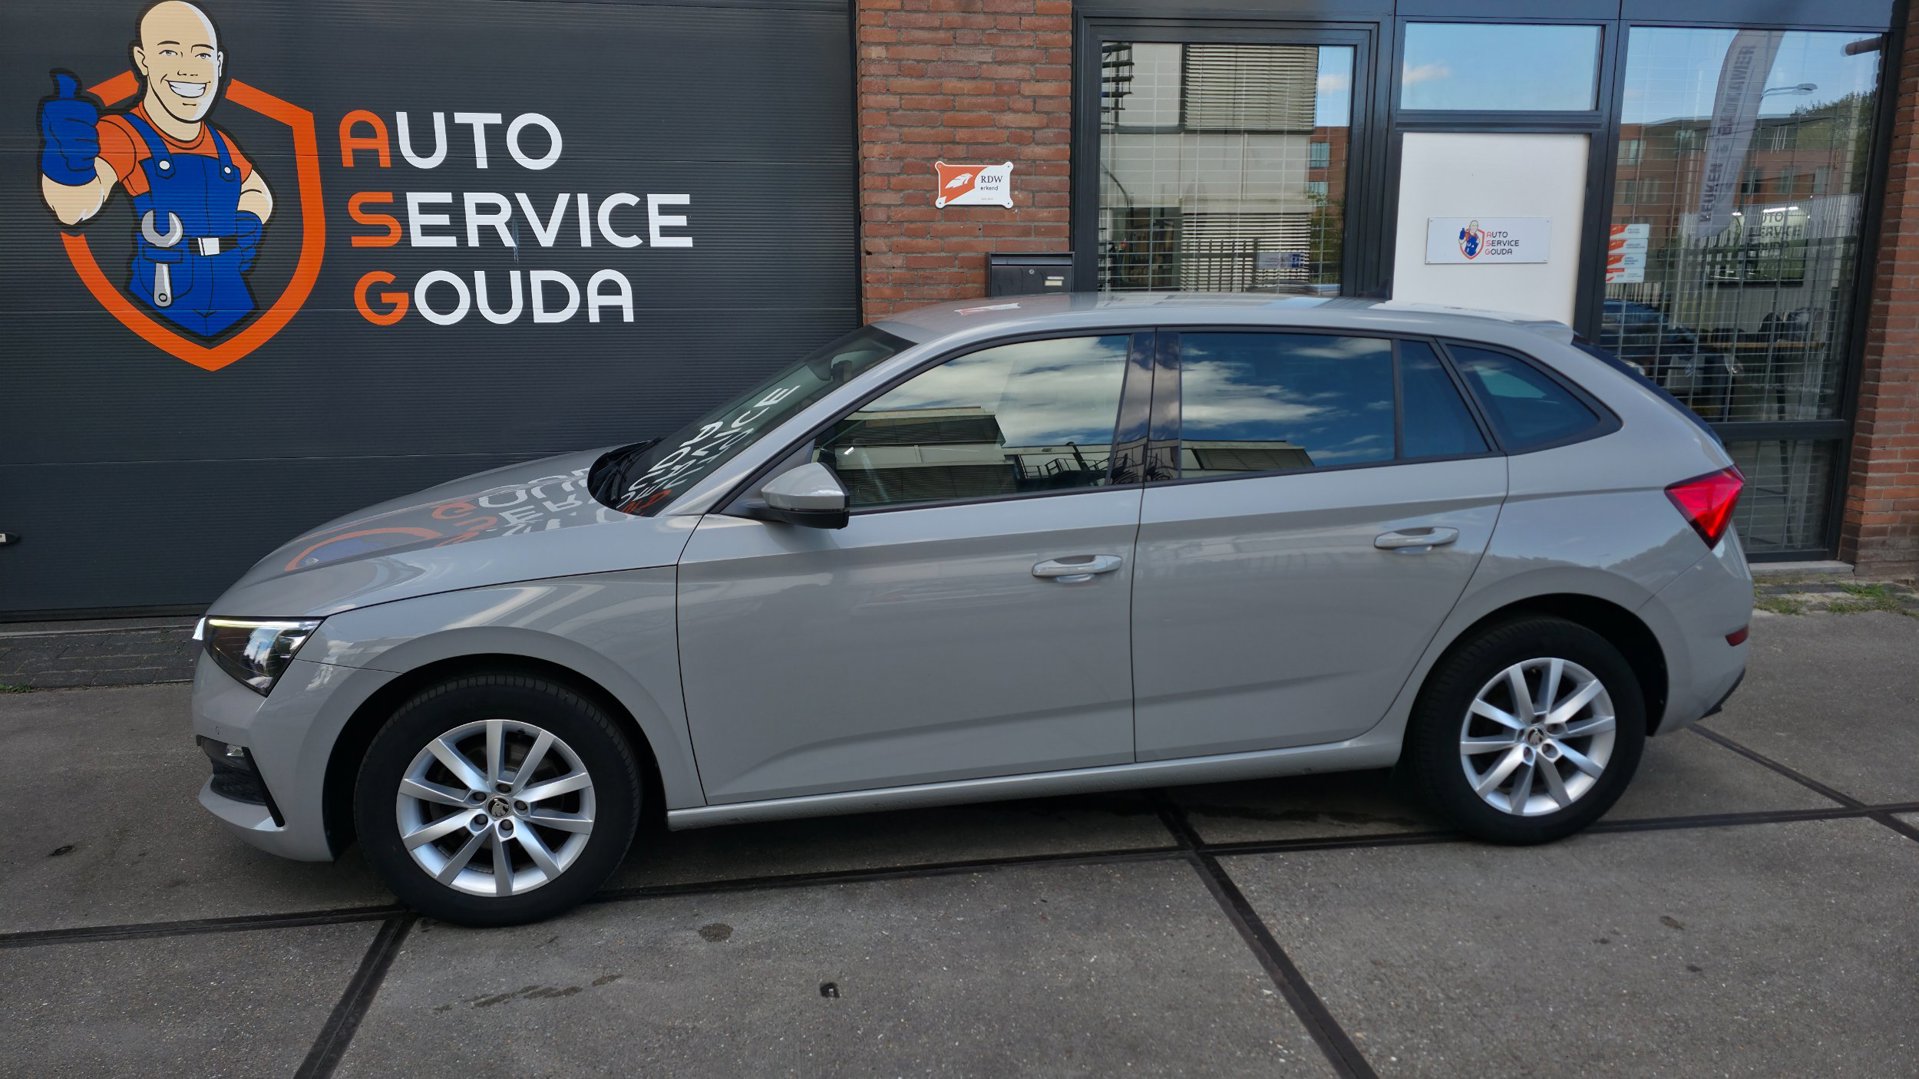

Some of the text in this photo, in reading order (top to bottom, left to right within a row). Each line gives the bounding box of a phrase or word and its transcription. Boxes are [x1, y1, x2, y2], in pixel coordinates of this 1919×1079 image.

[339, 109, 563, 170] AUTO
[980, 175, 1003, 184] RDW
[347, 191, 694, 248] SERVICE
[1486, 231, 1508, 239] AUTO
[1484, 248, 1513, 256] GOUDA
[353, 269, 635, 326] GOUDA
